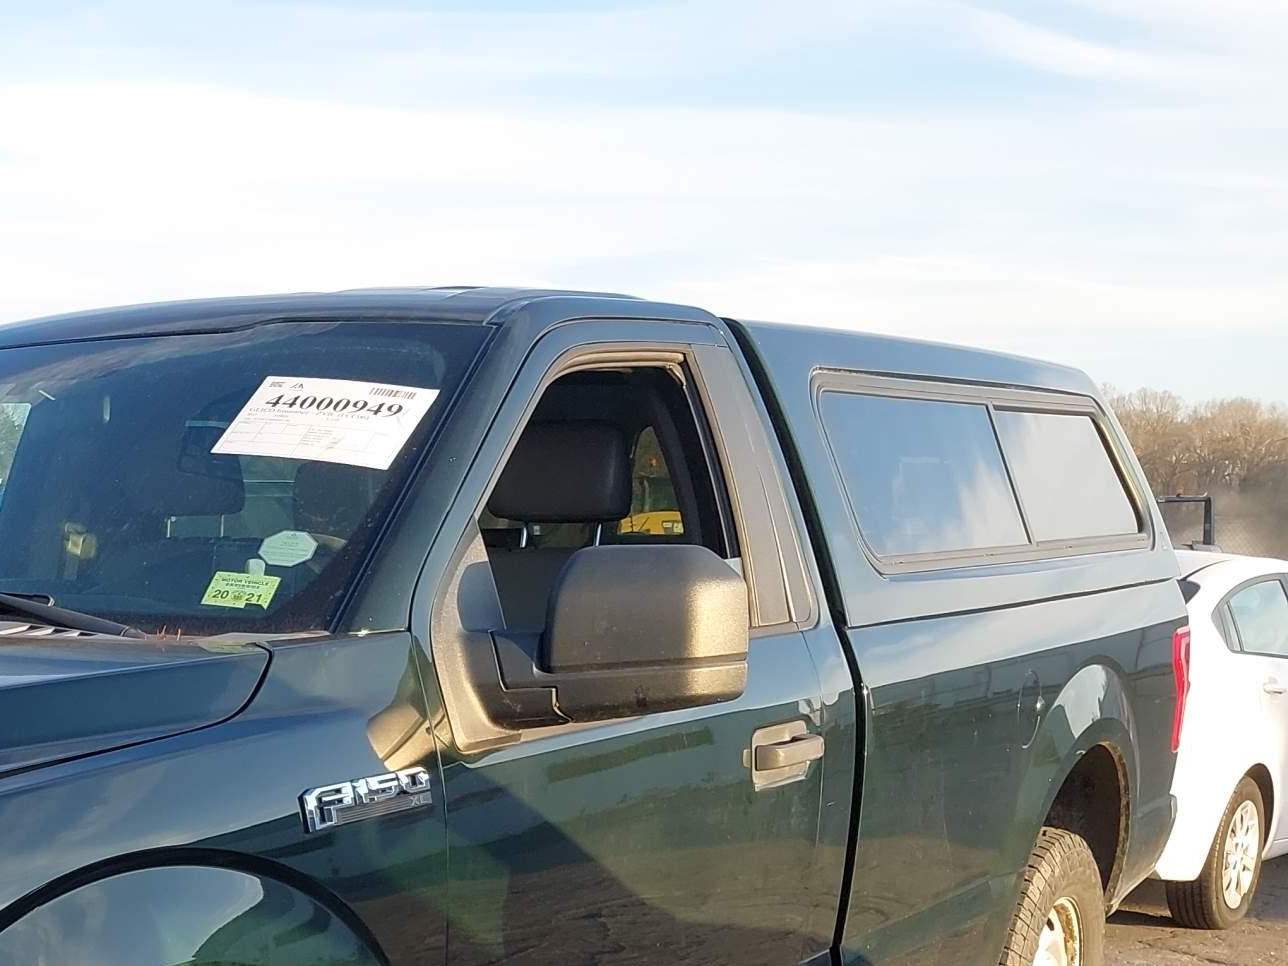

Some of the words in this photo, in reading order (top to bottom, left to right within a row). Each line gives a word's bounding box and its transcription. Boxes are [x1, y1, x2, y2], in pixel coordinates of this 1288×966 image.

[265, 394, 403, 418] 44000949
[212, 589, 230, 600] 20
[245, 592, 263, 603] 21
